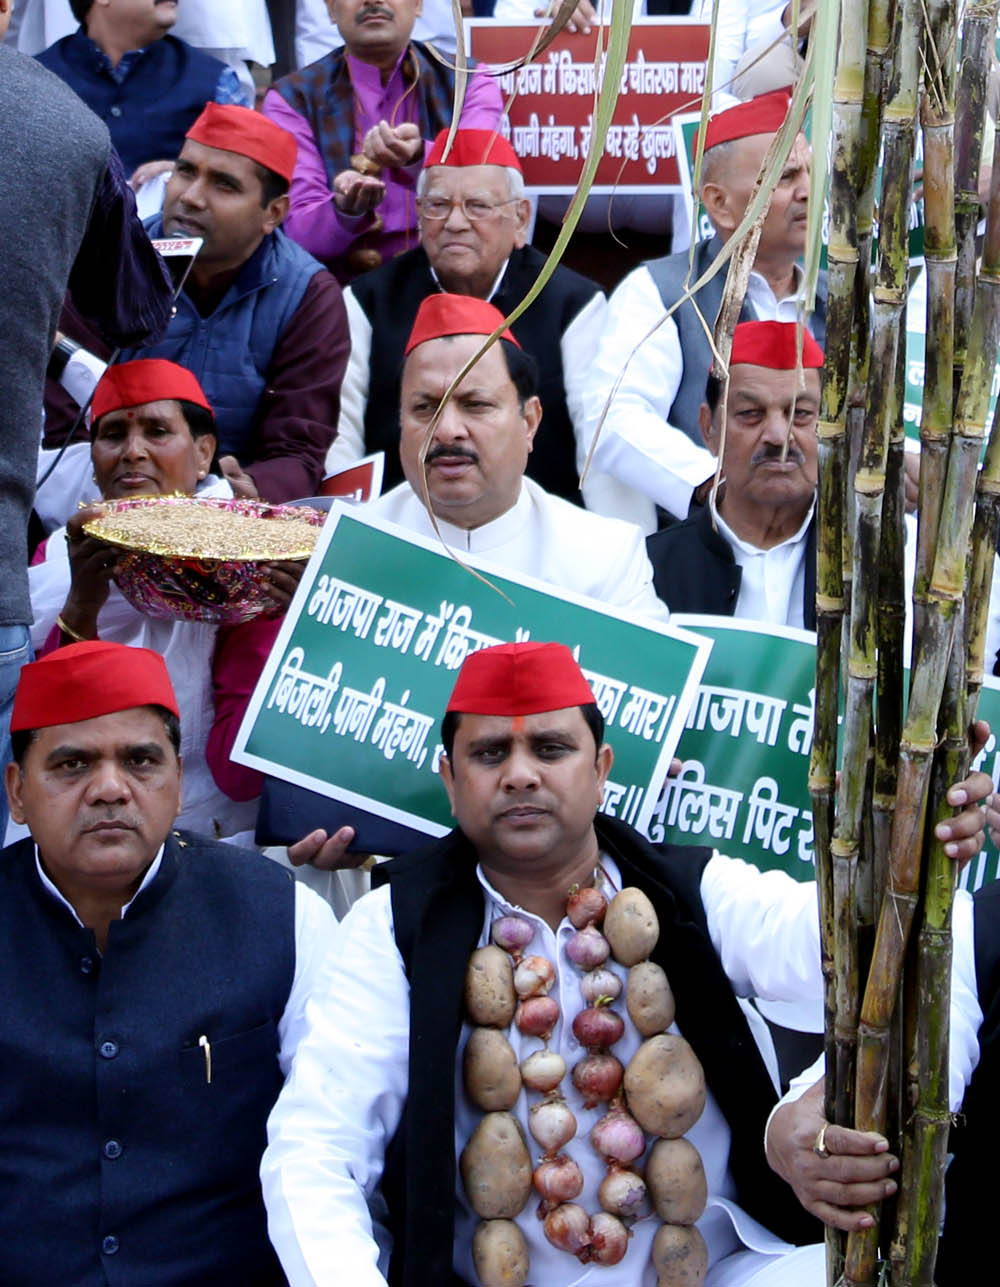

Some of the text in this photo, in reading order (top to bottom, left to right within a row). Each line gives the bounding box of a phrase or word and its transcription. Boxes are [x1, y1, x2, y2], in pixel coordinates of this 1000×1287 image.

[267, 646, 344, 734] बिजली,
[333, 676, 387, 744] पानी
[308, 573, 384, 640] भाजपा
[373, 599, 424, 654] राज
[414, 599, 455, 662] में
[619, 685, 677, 743] मार।
[743, 776, 800, 856] पिट
